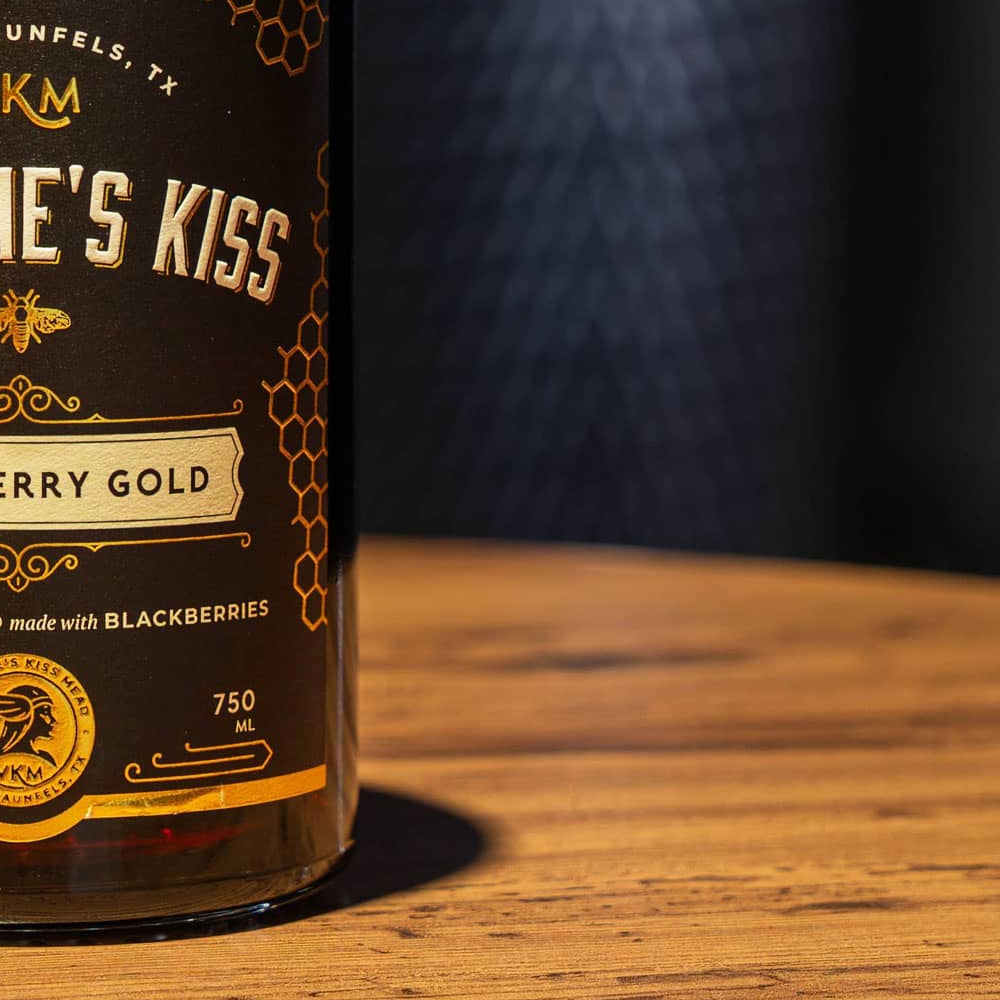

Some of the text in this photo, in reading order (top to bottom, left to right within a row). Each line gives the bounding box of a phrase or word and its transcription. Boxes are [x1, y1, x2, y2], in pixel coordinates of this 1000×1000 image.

[146, 63, 179, 97] TX
[152, 178, 292, 304] KISS
[108, 466, 209, 497] GOLD
[9, 613, 57, 632] made
[61, 613, 98, 632] with
[104, 600, 270, 630] BLACKBERRIES
[25, 658, 61, 676] KISS
[62, 677, 90, 717] MEAD
[213, 689, 256, 716] 750
[235, 719, 256, 733] ML
[71, 755, 87, 774] TX
